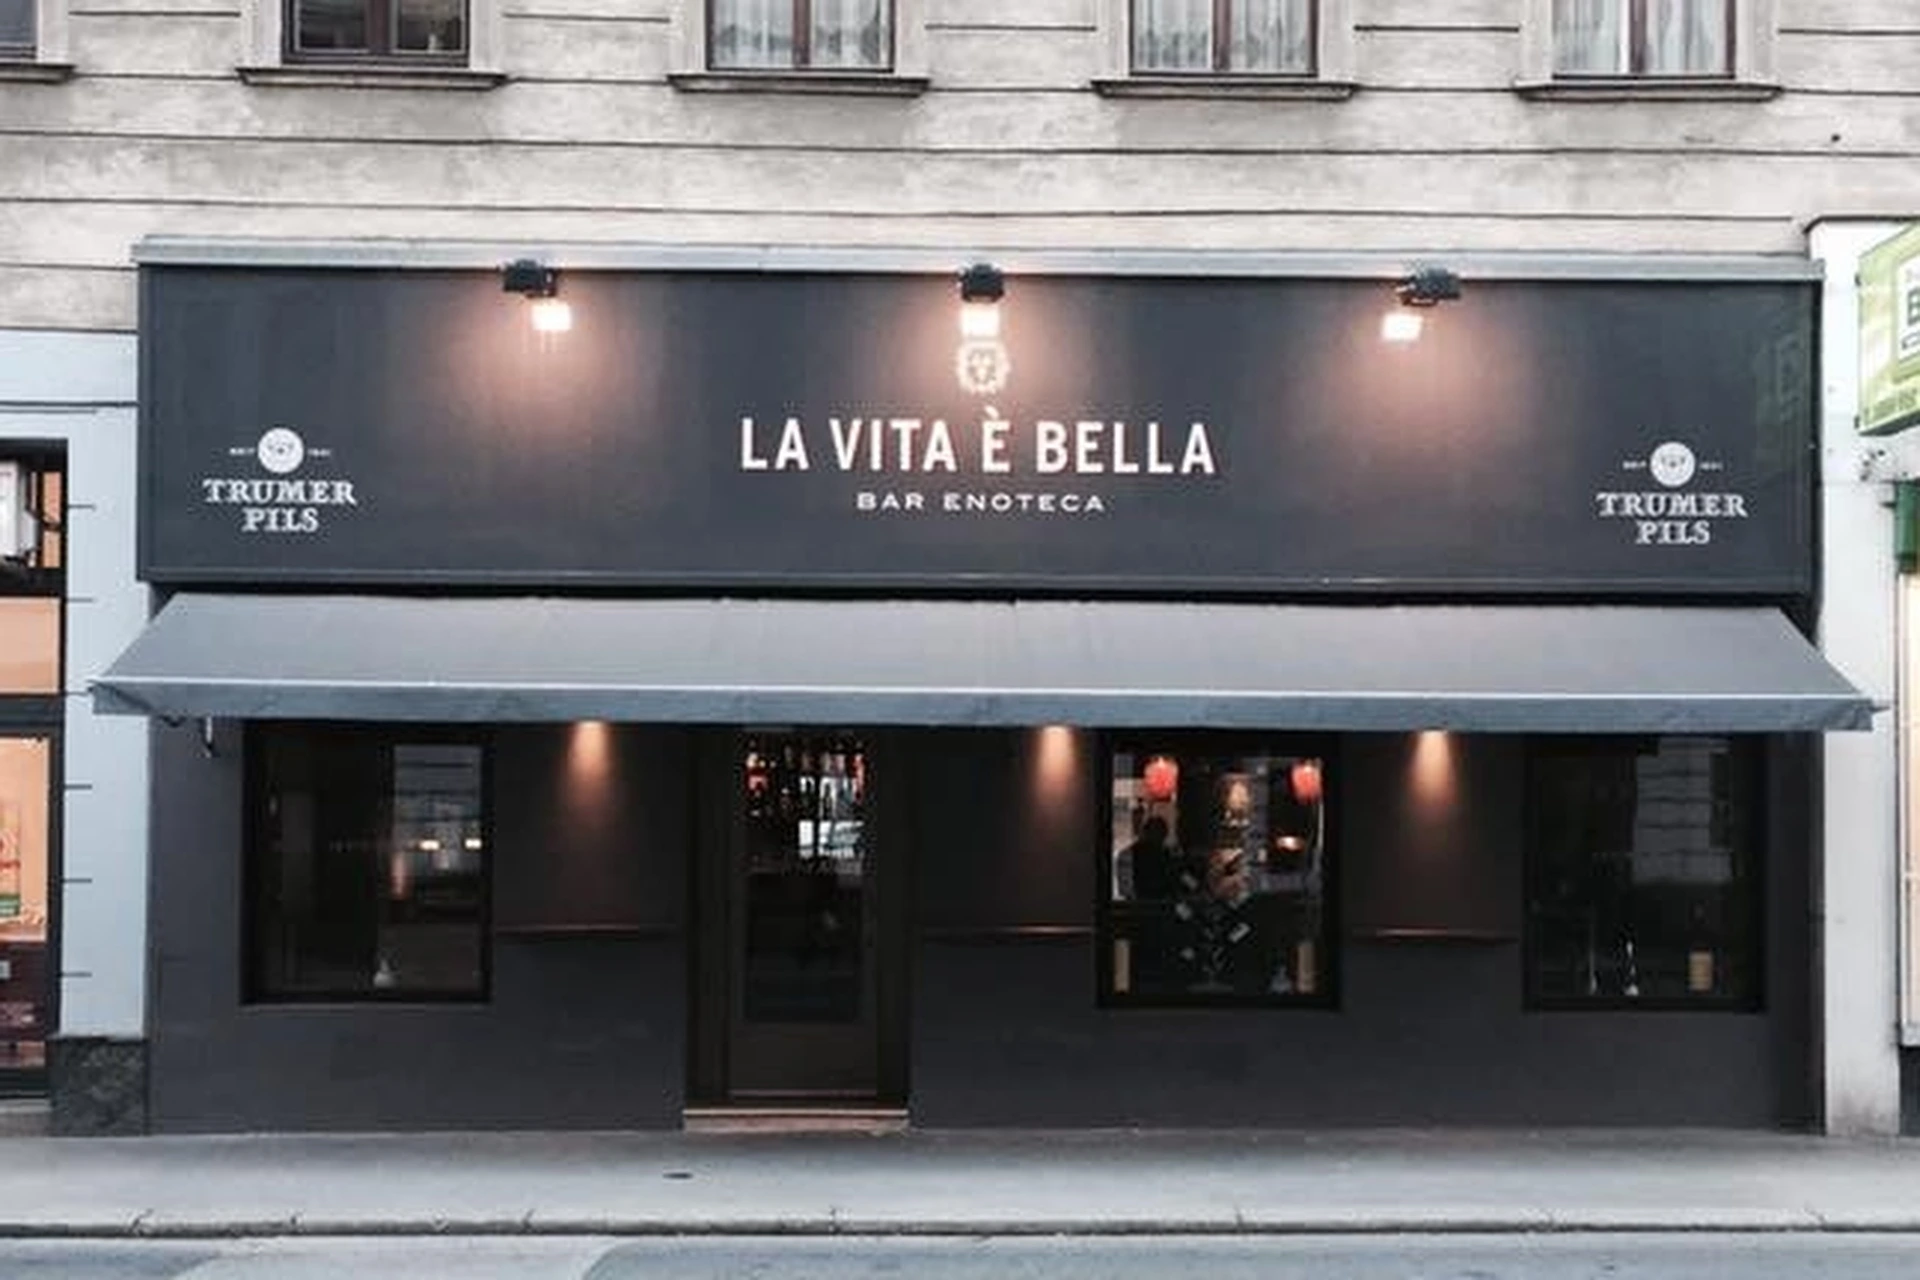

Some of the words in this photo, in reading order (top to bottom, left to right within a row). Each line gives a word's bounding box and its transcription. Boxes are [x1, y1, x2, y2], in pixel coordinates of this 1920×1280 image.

[742, 417, 809, 470] LA
[829, 418, 957, 472] VITA
[982, 405, 1010, 473] È
[1036, 420, 1214, 474] BELLA
[202, 478, 358, 505] TRUMER
[857, 492, 924, 510] BAR
[943, 493, 1105, 512] ENOTECA
[1596, 492, 1748, 517] TRUMER
[241, 507, 319, 532] PILS
[1636, 519, 1710, 544] PILS
